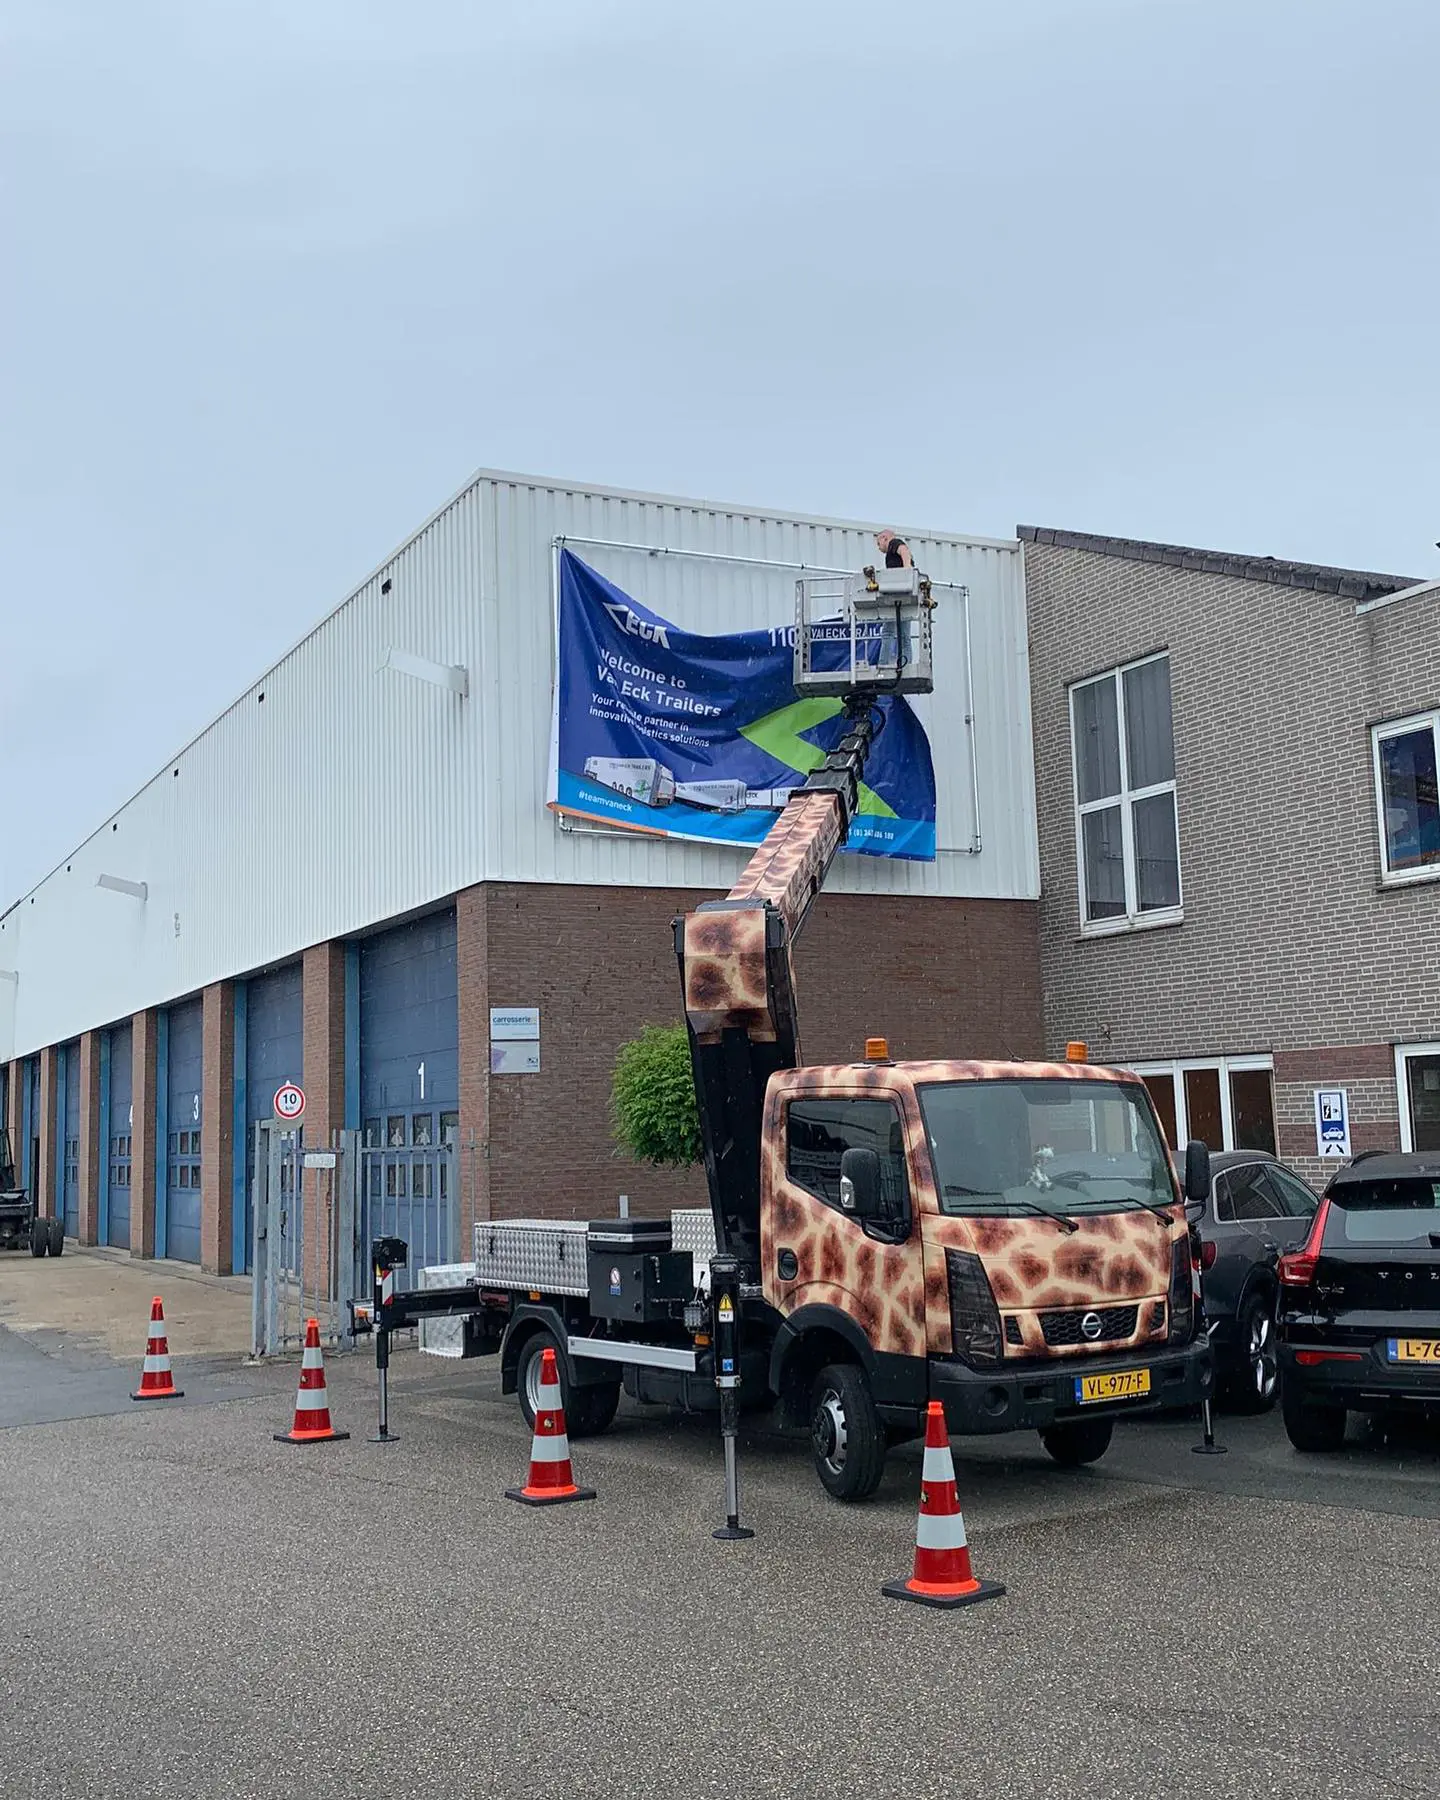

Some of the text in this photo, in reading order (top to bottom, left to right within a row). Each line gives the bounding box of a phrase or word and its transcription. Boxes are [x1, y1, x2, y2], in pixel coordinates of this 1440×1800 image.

[768, 627, 795, 648] 110
[825, 628, 847, 639] ECK
[597, 665, 722, 717] Va Eck Trailers
[671, 675, 687, 689] to
[592, 693, 614, 709] Your
[644, 715, 679, 731] partner
[680, 721, 689, 732] in
[670, 733, 710, 748] solutions
[578, 790, 633, 812] #teamvaneck
[418, 1061, 425, 1100] 1
[193, 1094, 199, 1121] 3
[283, 1093, 297, 1105] 10
[1088, 1373, 1144, 1396] VL-977-F
